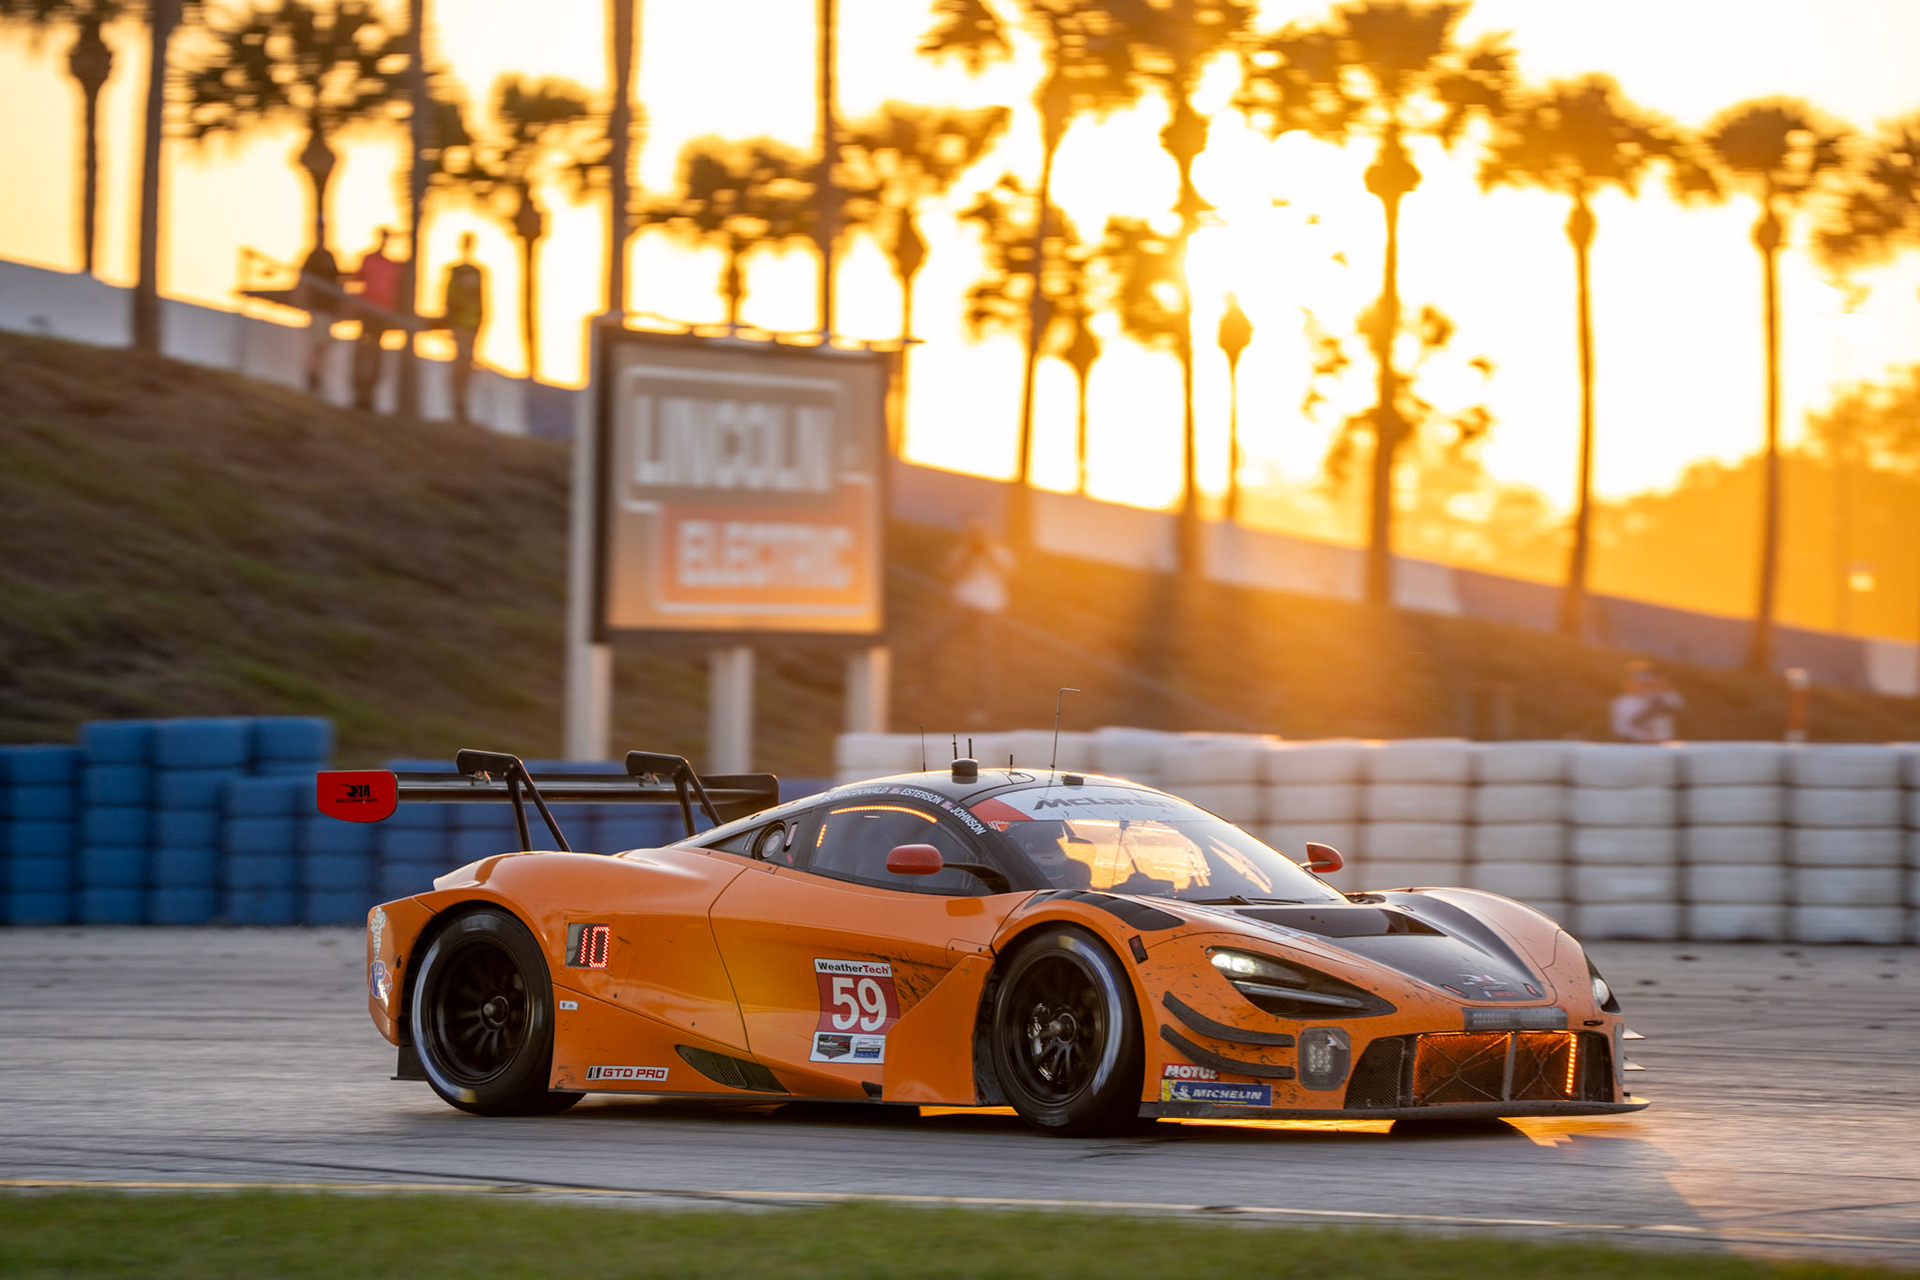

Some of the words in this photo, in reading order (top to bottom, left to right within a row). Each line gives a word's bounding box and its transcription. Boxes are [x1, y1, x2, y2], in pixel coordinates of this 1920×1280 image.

[634, 394, 833, 492] LINCOLN
[677, 520, 853, 588] ELECTRIC
[899, 788, 945, 804] ESTERSON
[1033, 796, 1179, 811] McLaren
[949, 807, 987, 836] JOHNSON
[580, 926, 611, 968] 10
[817, 962, 890, 975] WeatherTech
[832, 977, 888, 1032] 59
[602, 1068, 633, 1078] GTD
[636, 1069, 666, 1079] PRO
[1192, 1089, 1263, 1100] MICHELIN
